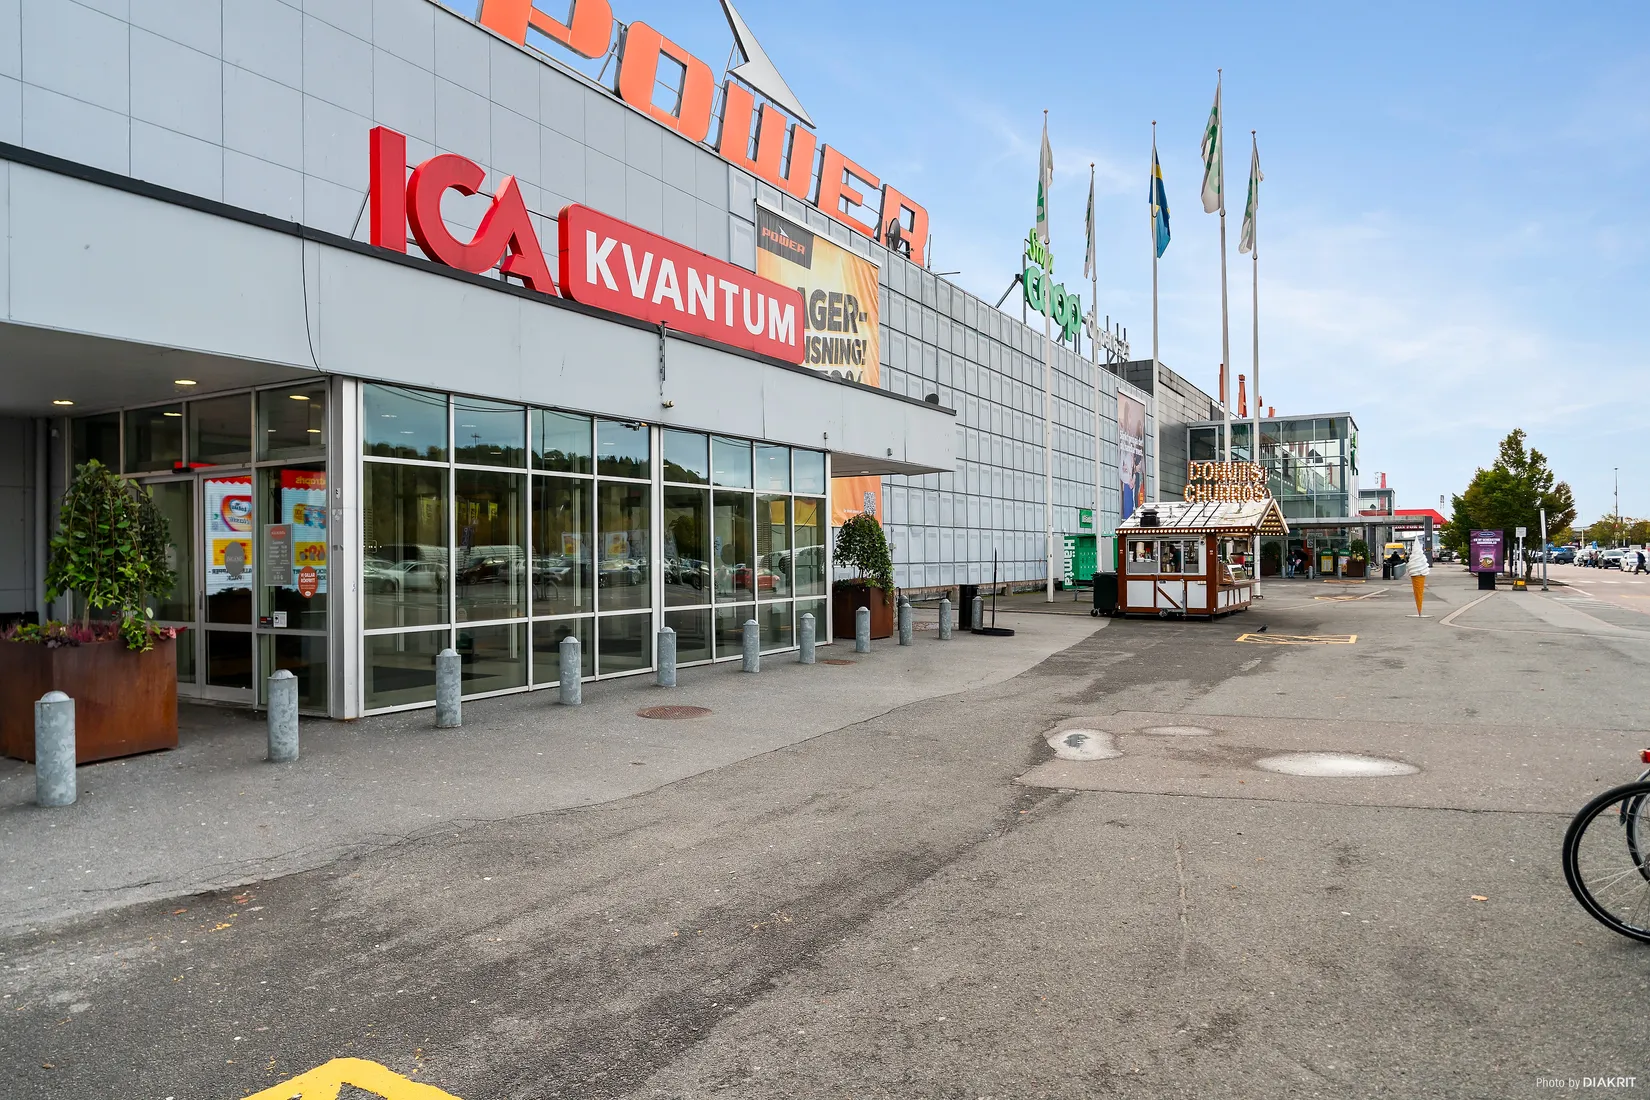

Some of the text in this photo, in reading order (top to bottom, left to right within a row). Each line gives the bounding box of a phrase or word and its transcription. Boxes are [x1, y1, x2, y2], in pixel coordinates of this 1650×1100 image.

[477, 0, 929, 266] POWER
[369, 126, 796, 346] ICA KVANTUM
[762, 227, 806, 255] POWER
[1027, 228, 1054, 274] Stoa
[1183, 483, 1265, 503] CHURROS
[1188, 461, 1262, 481] DONUTS
[1064, 539, 1076, 586] Hämta
